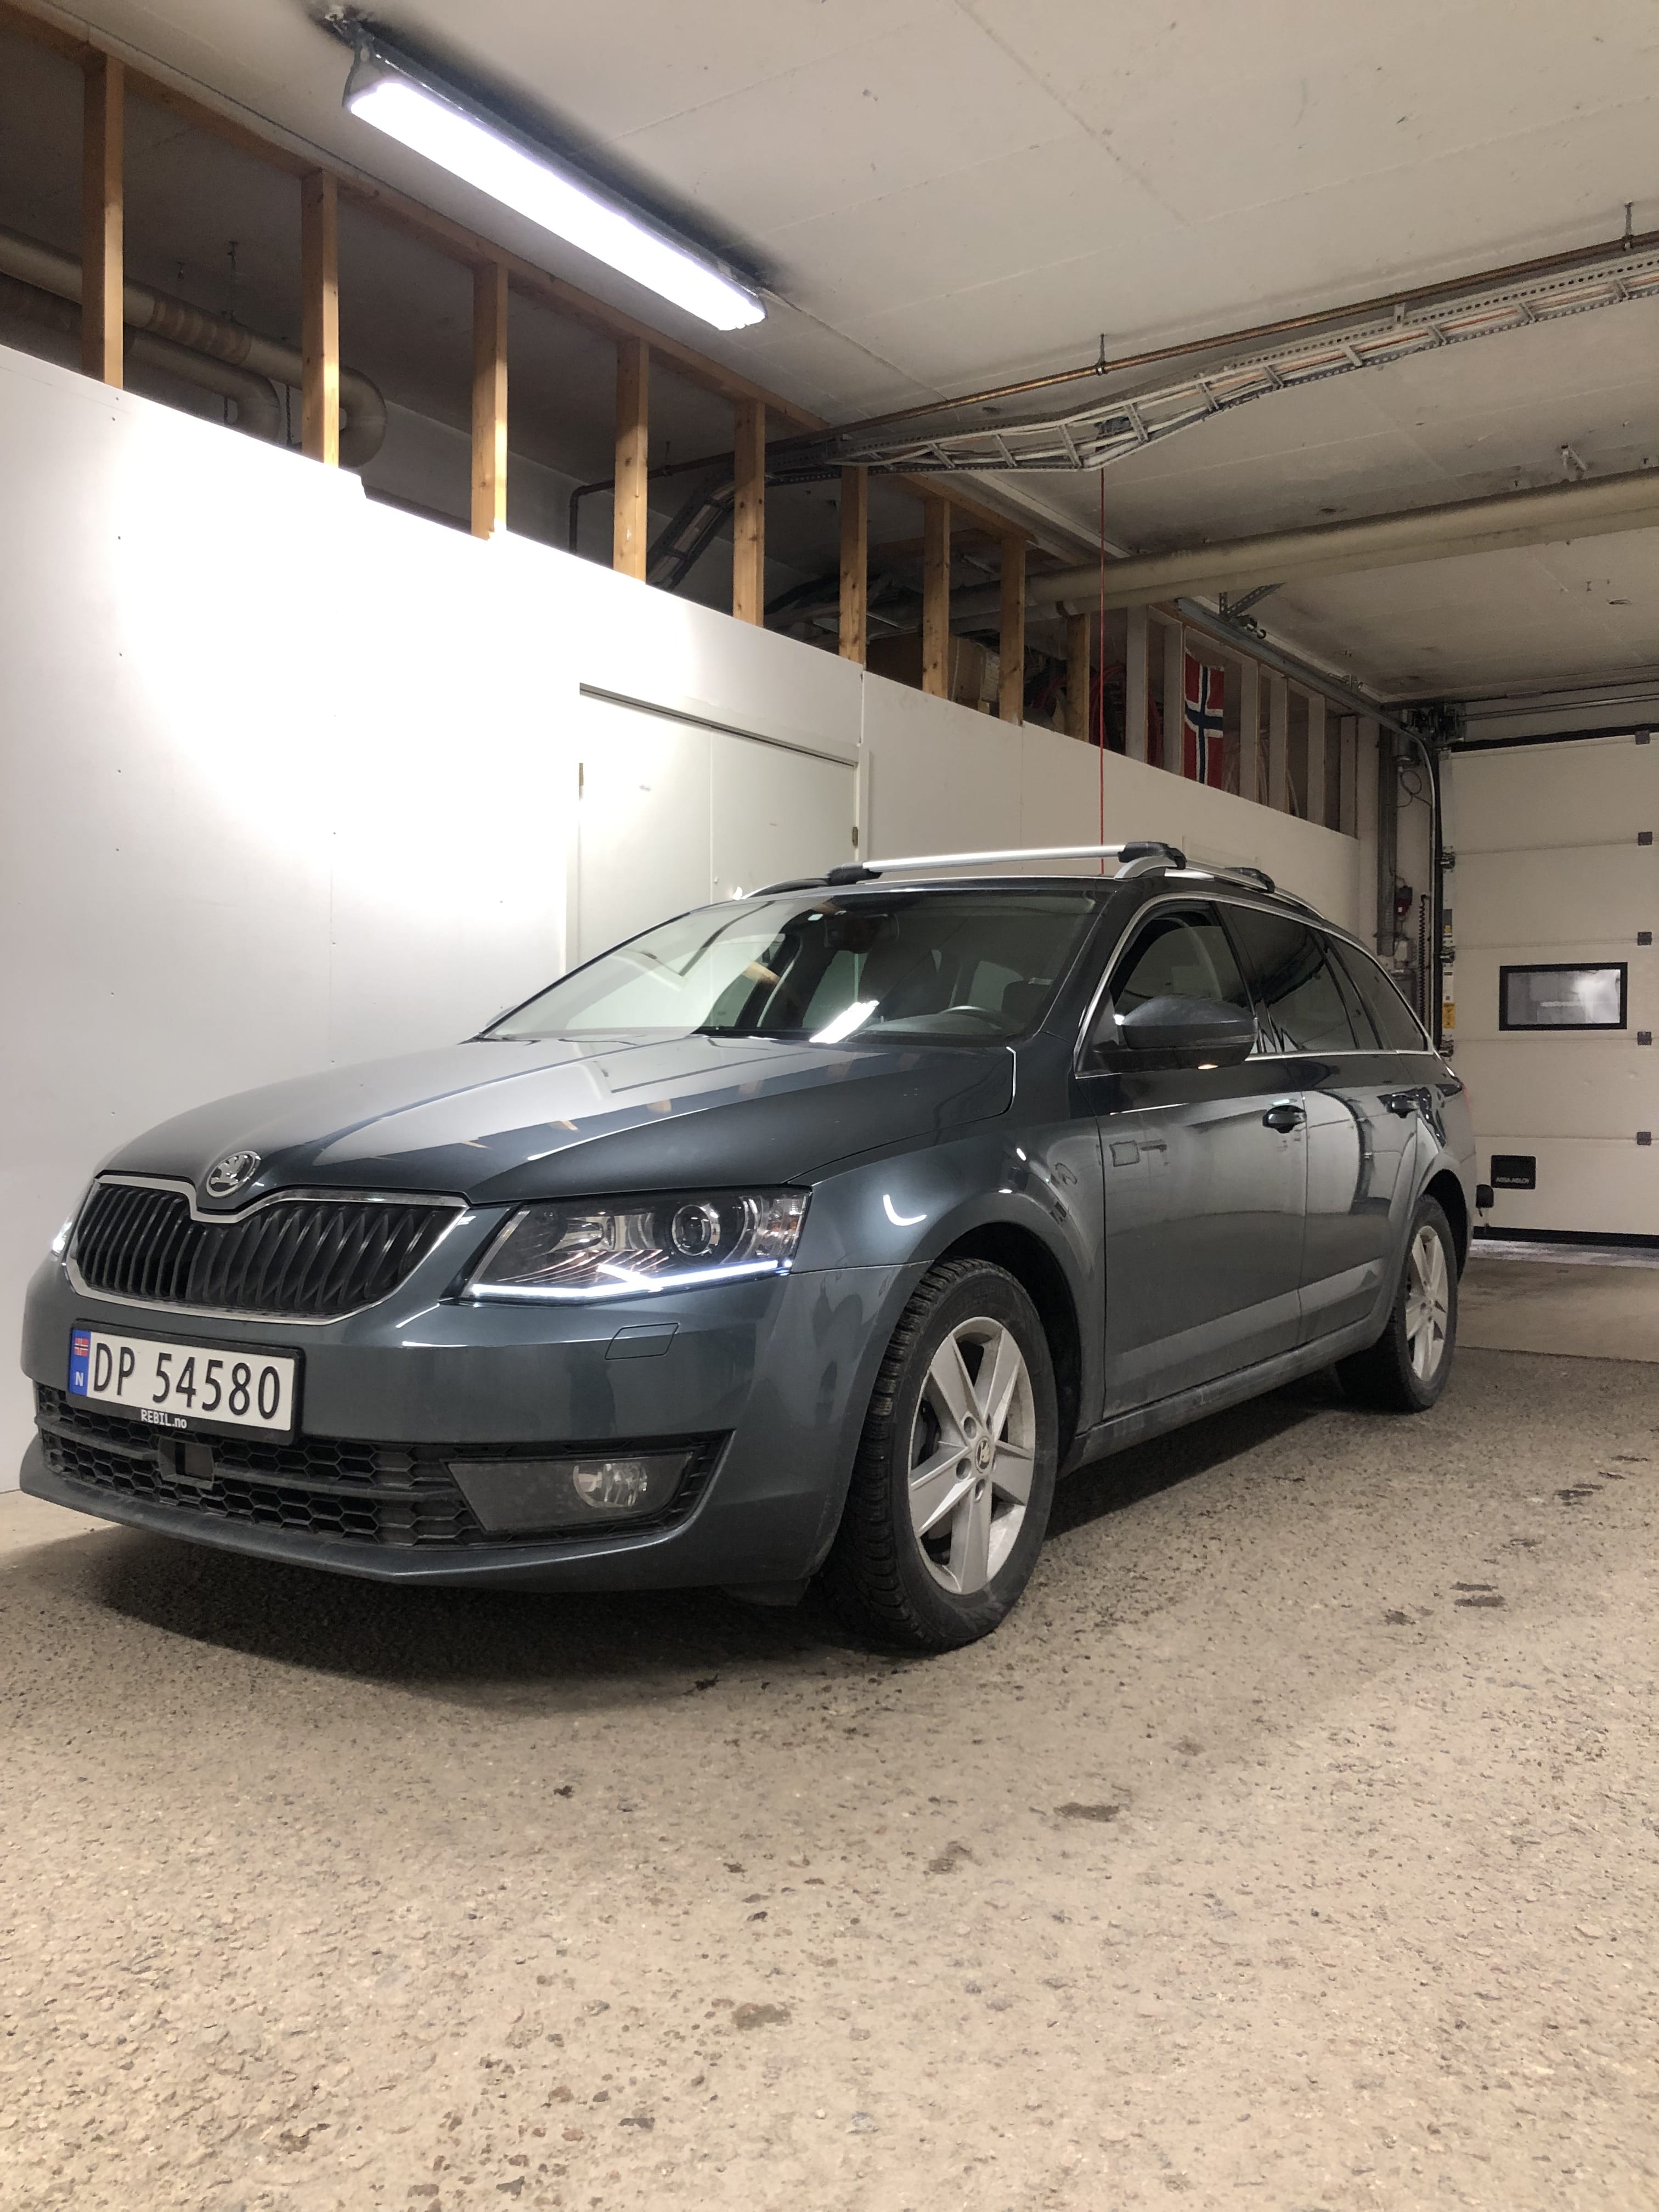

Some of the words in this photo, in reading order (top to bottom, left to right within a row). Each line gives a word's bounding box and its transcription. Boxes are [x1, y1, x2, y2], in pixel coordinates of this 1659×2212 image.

[75, 1372, 84, 1387] N
[94, 1342, 135, 1396] DP
[153, 1352, 280, 1419] 54580
[140, 1409, 187, 1429] REBIL.no
